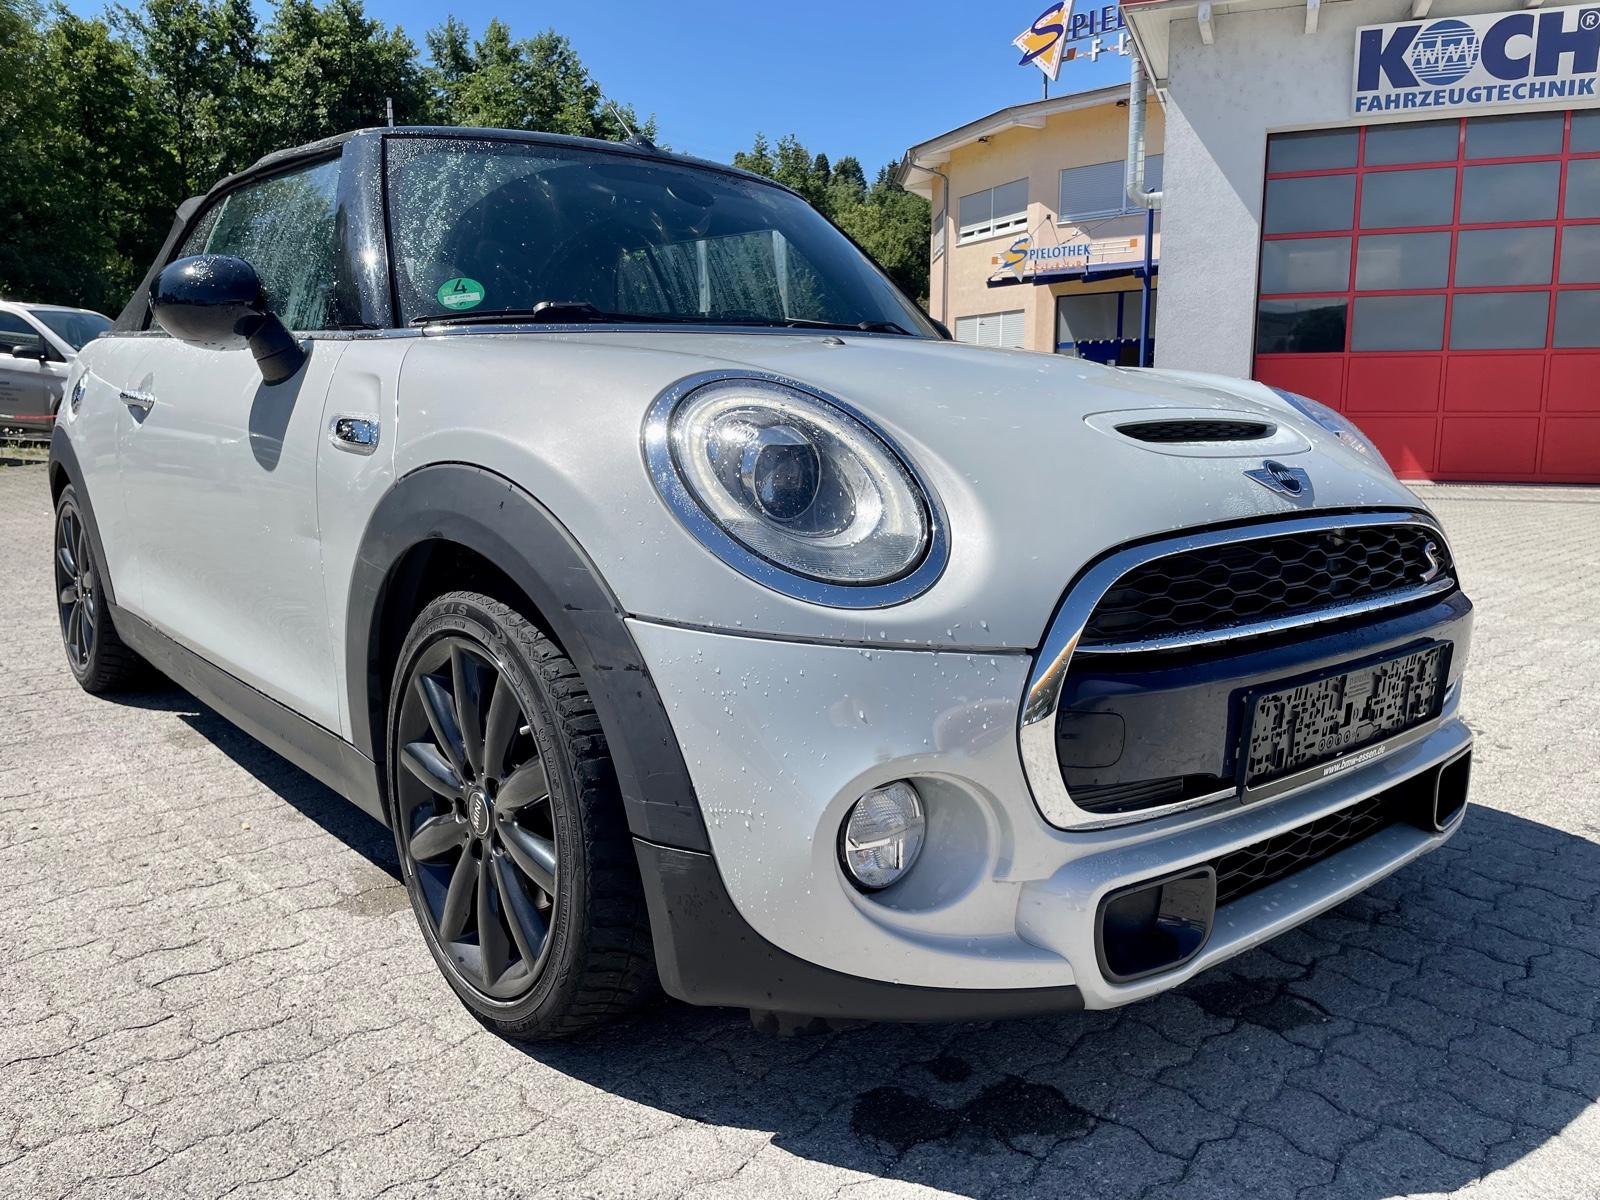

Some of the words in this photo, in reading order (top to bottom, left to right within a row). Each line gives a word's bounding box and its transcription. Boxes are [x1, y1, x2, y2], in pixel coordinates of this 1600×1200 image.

[1355, 77, 1596, 113] FAHRZEUGTECHNIK
[1002, 237, 1091, 269] SPIELOTHEK
[453, 279, 467, 293] 4
[473, 798, 482, 829] MINI
